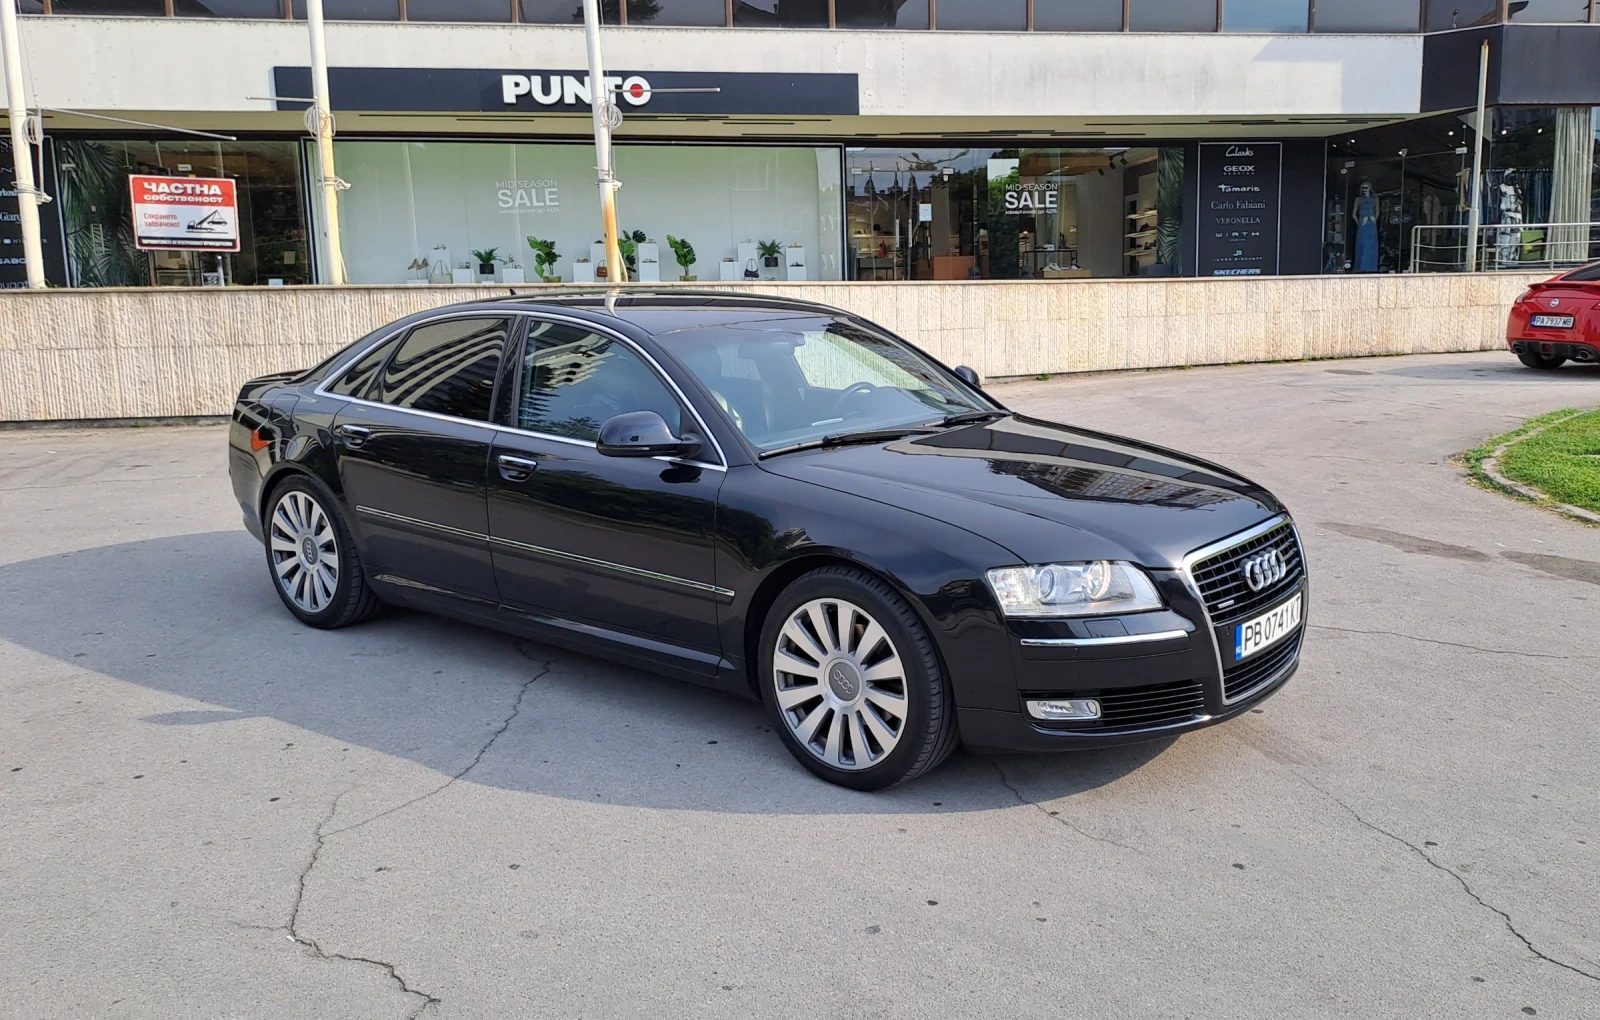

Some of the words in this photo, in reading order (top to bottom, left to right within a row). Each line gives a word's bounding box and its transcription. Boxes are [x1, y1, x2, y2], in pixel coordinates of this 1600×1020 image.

[502, 75, 651, 106] PUNTO
[1225, 145, 1254, 157] Clarks
[143, 182, 222, 195] ЧАСТНА
[496, 181, 515, 189] MID
[518, 180, 558, 188] SEASON
[497, 188, 560, 208] SALE
[1005, 191, 1057, 208] SALE
[1211, 201, 1234, 210] Carlo
[1236, 200, 1266, 209] Fabiani
[144, 213, 178, 221] Спирането
[1213, 268, 1261, 276] SKECHERS
[1536, 317, 1545, 325] PA
[1545, 318, 1562, 326] 7937
[1244, 622, 1262, 652] PB
